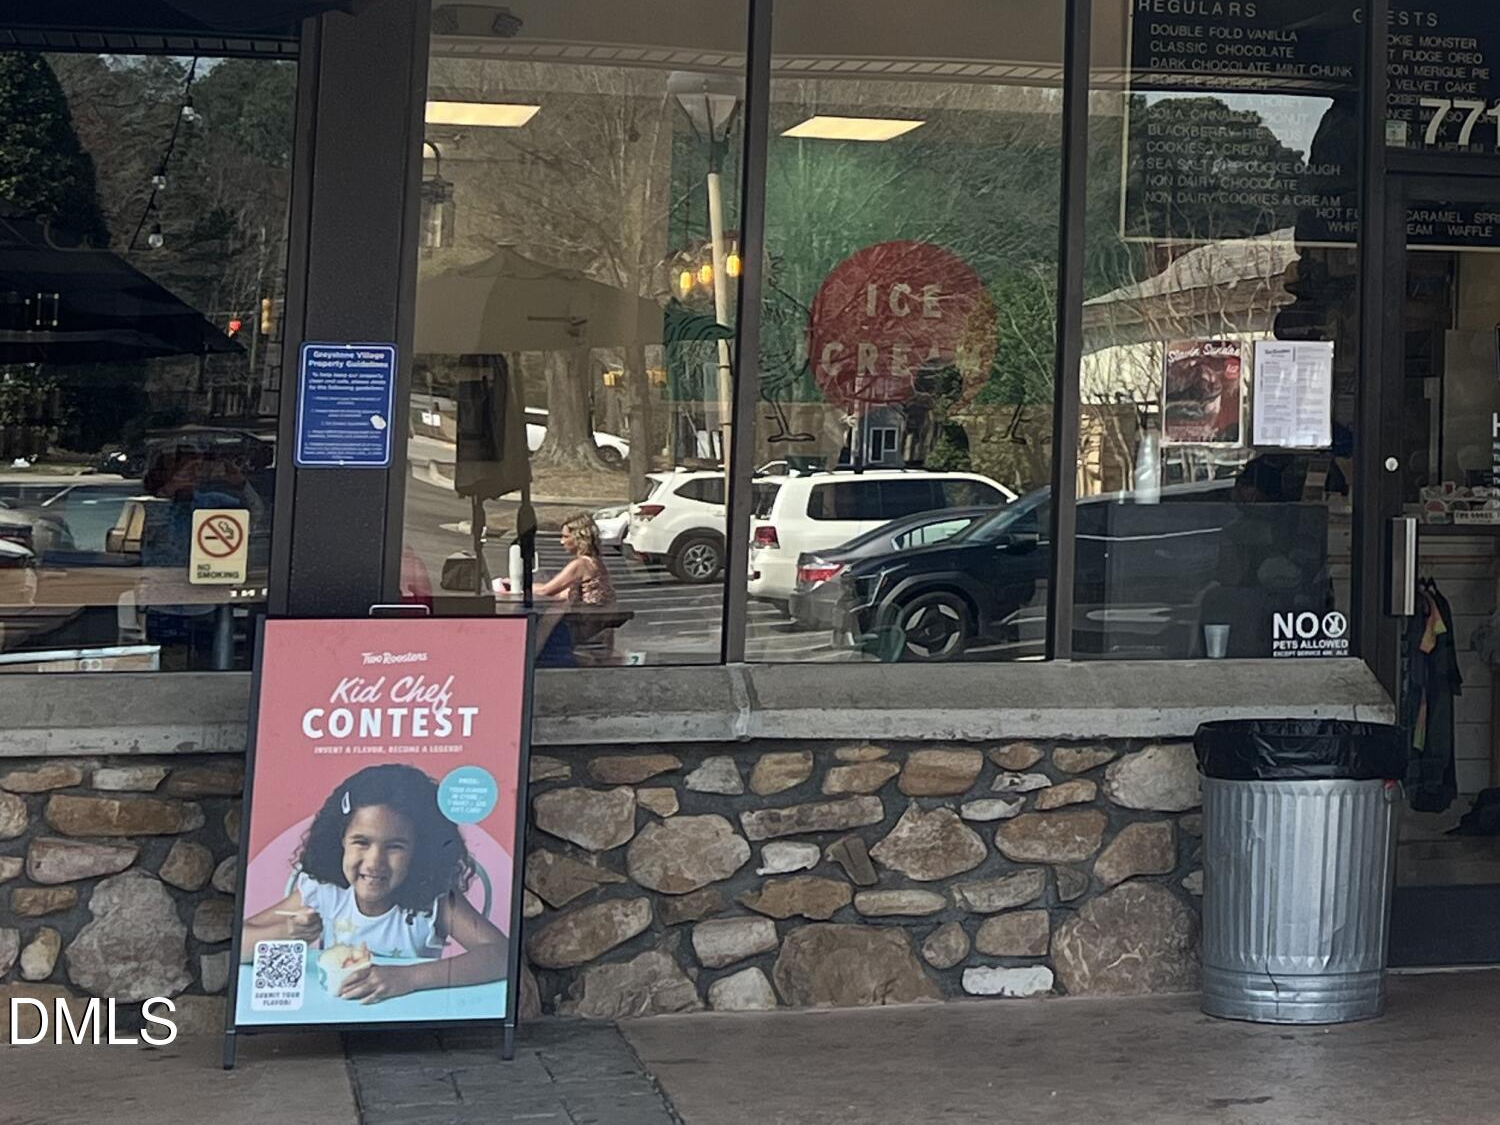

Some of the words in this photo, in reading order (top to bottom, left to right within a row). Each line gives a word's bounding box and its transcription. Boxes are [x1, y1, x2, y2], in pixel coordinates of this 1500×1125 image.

[1150, 24, 1204, 37] DOUBLE
[1209, 27, 1243, 39] FOLD
[1246, 29, 1298, 43] VANILLA
[1150, 40, 1207, 54] CLASSIC
[1216, 43, 1295, 58] CHOCOLATE
[1420, 35, 1477, 49] MONSTER
[1403, 50, 1443, 62] FUDGE
[1448, 52, 1484, 65] OREO
[1150, 57, 1186, 70] DARK
[1191, 59, 1270, 74] CHOCOLATE
[1308, 64, 1353, 78] CHUNK
[1396, 79, 1440, 91] VELVET
[1445, 81, 1477, 93] CAKE
[1146, 140, 1206, 154] COOKIES
[1223, 143, 1270, 156] CREAM
[1146, 157, 1173, 170] SEA
[1146, 175, 1174, 187] NON
[1177, 175, 1216, 188] DAIRY
[1220, 177, 1298, 191] CHOCOLATE
[1145, 191, 1174, 204] NON
[1219, 192, 1280, 206] COOKIES
[1293, 194, 1341, 208] CREAM
[1447, 225, 1493, 238] WAFFLE
[866, 283, 943, 319] ICE
[356, 351, 385, 361] Village
[308, 360, 345, 369] Property
[197, 571, 240, 579] SMOKING
[1273, 611, 1319, 639] NO
[1273, 640, 1298, 650] PETS
[1300, 639, 1349, 649] ALLOWED
[361, 652, 382, 665] Two
[382, 651, 428, 664] Roosters
[330, 676, 386, 703] Kid
[390, 675, 455, 716] Chef
[303, 707, 479, 739] CONTEST
